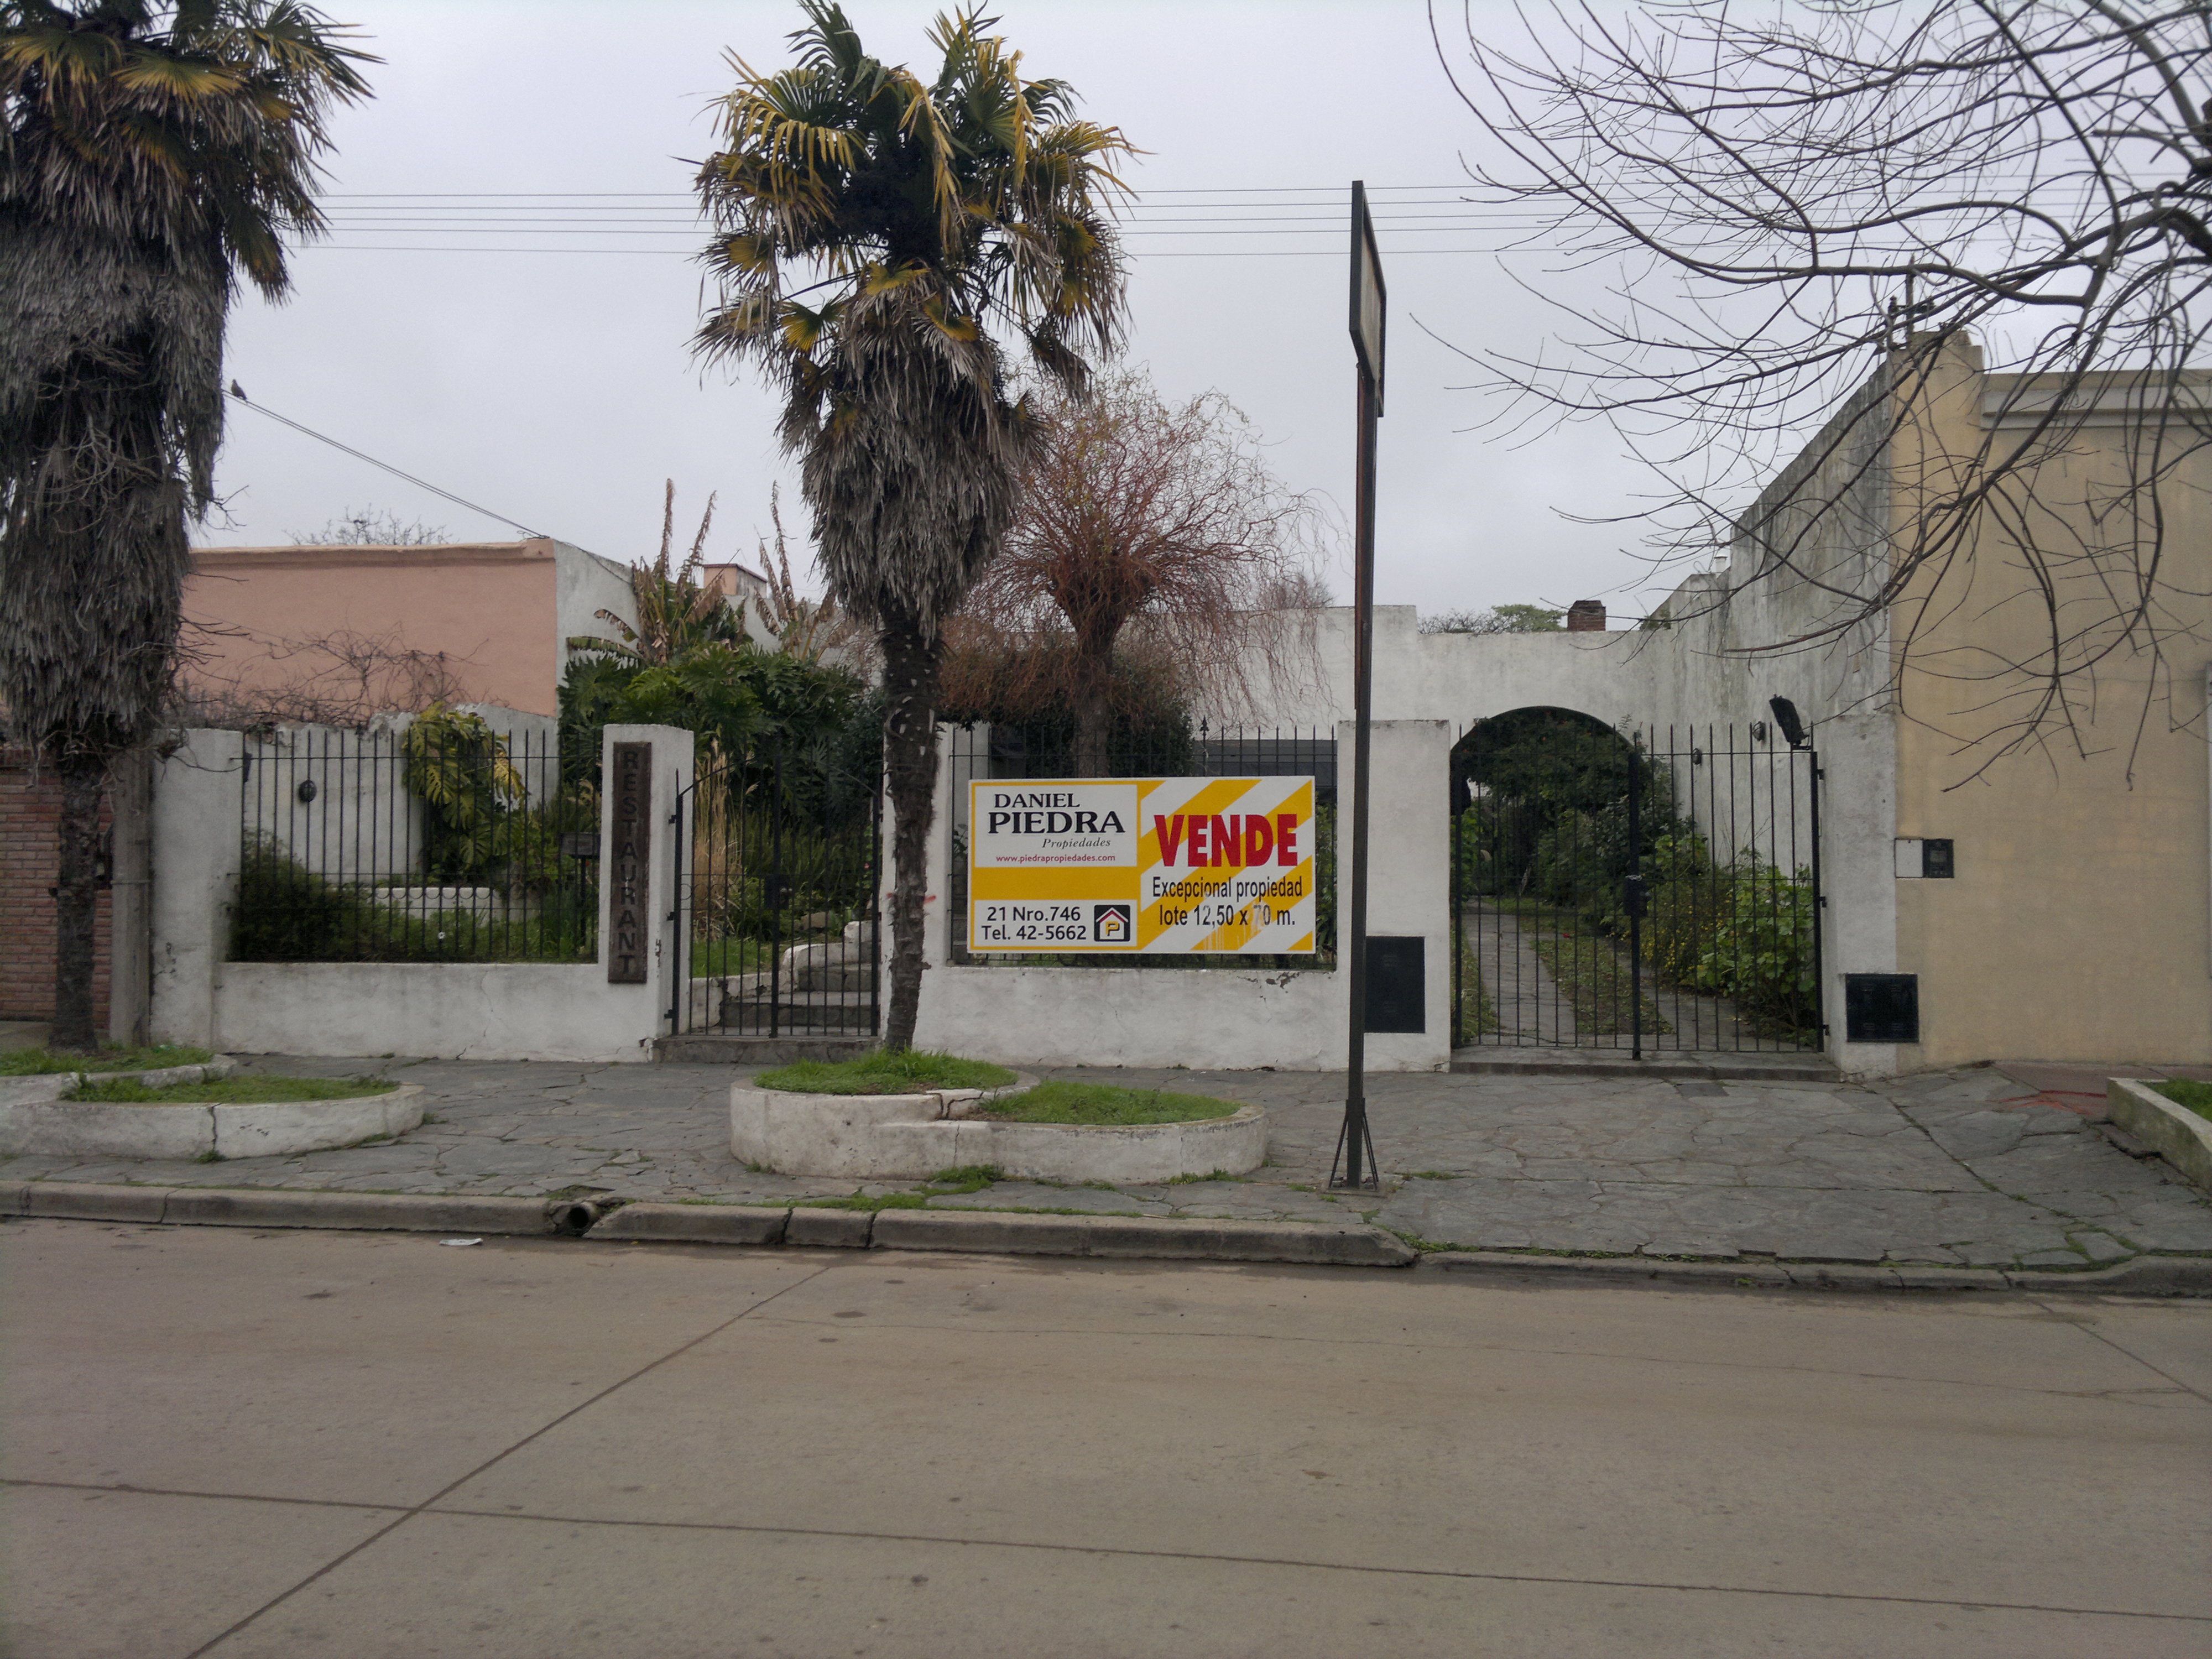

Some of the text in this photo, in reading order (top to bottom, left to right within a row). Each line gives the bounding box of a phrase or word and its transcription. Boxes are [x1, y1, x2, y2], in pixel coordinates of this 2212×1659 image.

[994, 793, 1080, 808] DANIEL
[988, 811, 1125, 834] PIEDRA
[1042, 837, 1111, 849] Propiedades
[1154, 814, 1298, 867] VENDE
[618, 750, 639, 974] RESTAURANT
[996, 854, 1116, 864] www.piedrapropiedades.com
[1152, 876, 1303, 902] Excepcional propiedad
[987, 906, 1081, 922] 21 Nro.746
[1159, 905, 1188, 926] lote
[1194, 905, 1234, 929] 12,50
[1239, 910, 1248, 925] x
[1277, 909, 1295, 925] m.
[981, 924, 1087, 940] Tel. 42-5662
